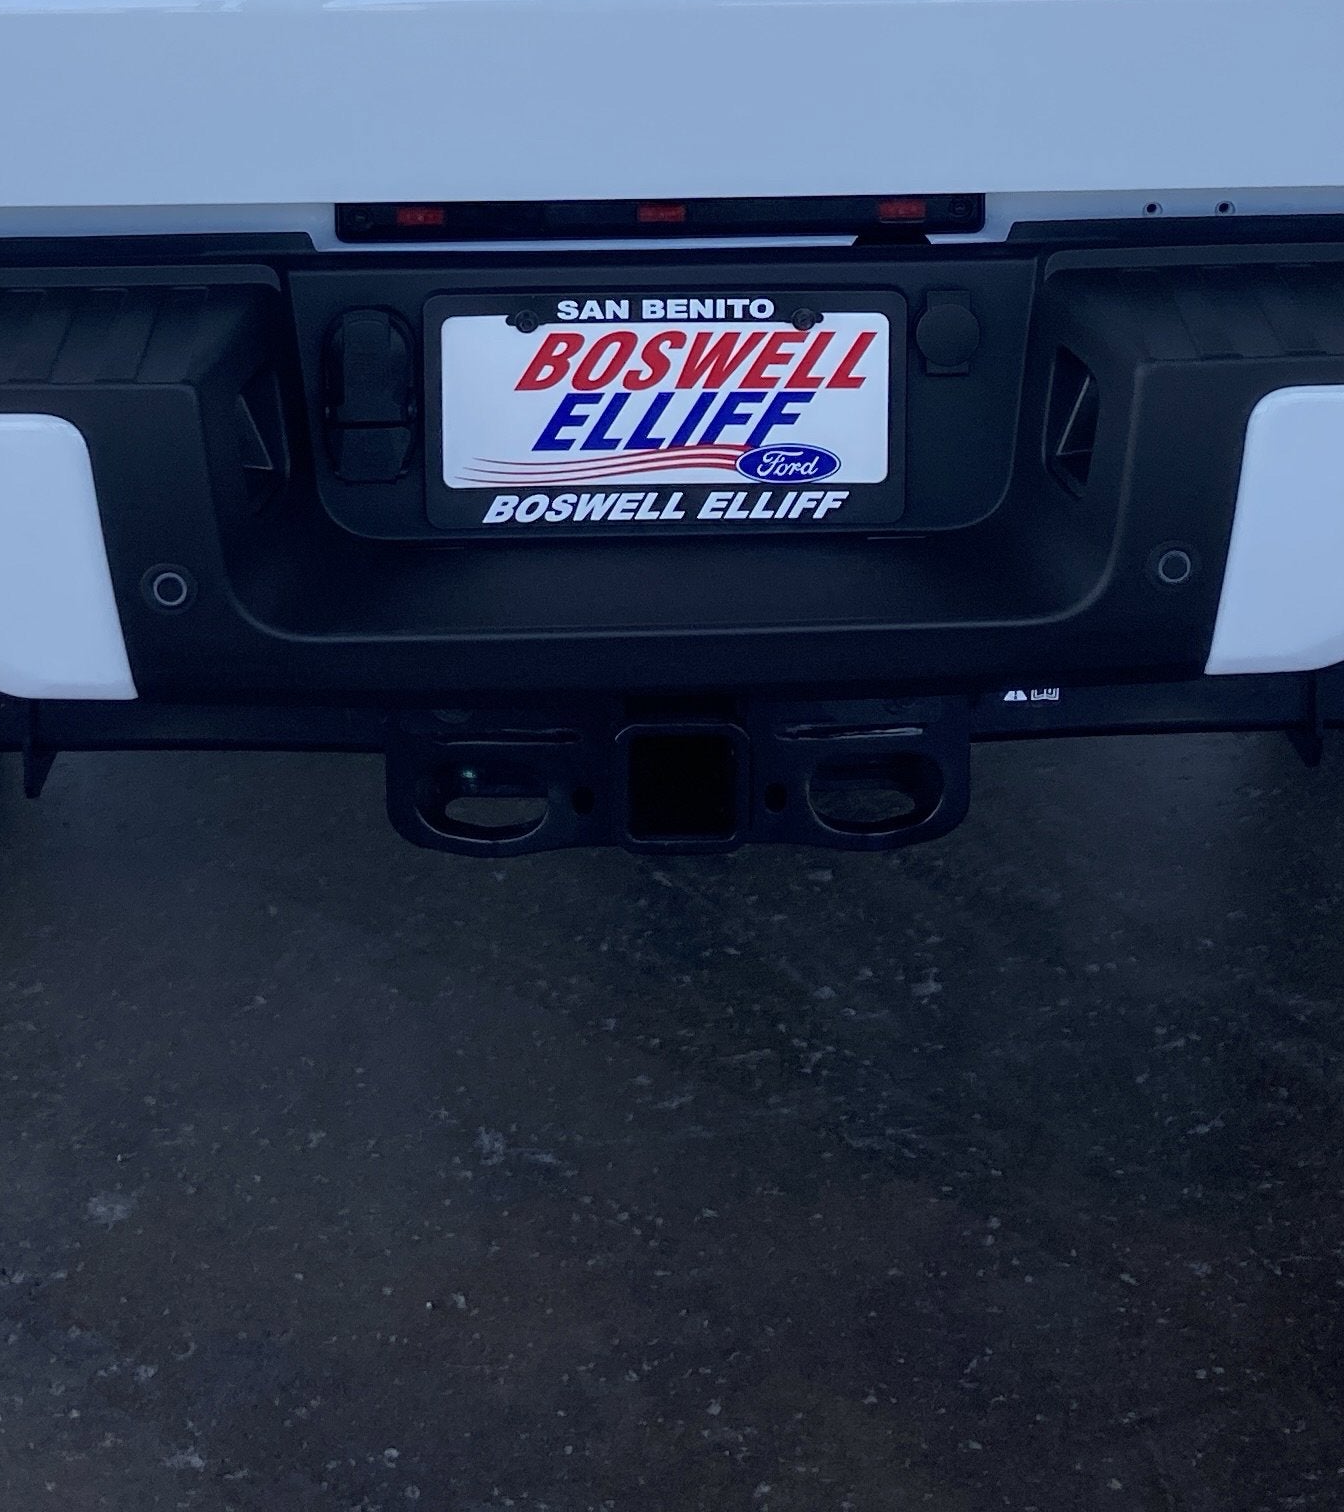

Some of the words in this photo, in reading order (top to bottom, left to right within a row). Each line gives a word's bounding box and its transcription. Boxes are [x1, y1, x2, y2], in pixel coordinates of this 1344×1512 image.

[557, 300, 629, 319] SAN
[641, 299, 774, 319] BENITO
[514, 331, 877, 391] BOSWELL
[532, 392, 816, 451] ELLIFF
[756, 451, 820, 478] Ford
[482, 492, 686, 523] BOSWELL
[696, 491, 849, 520] ELLIFF
